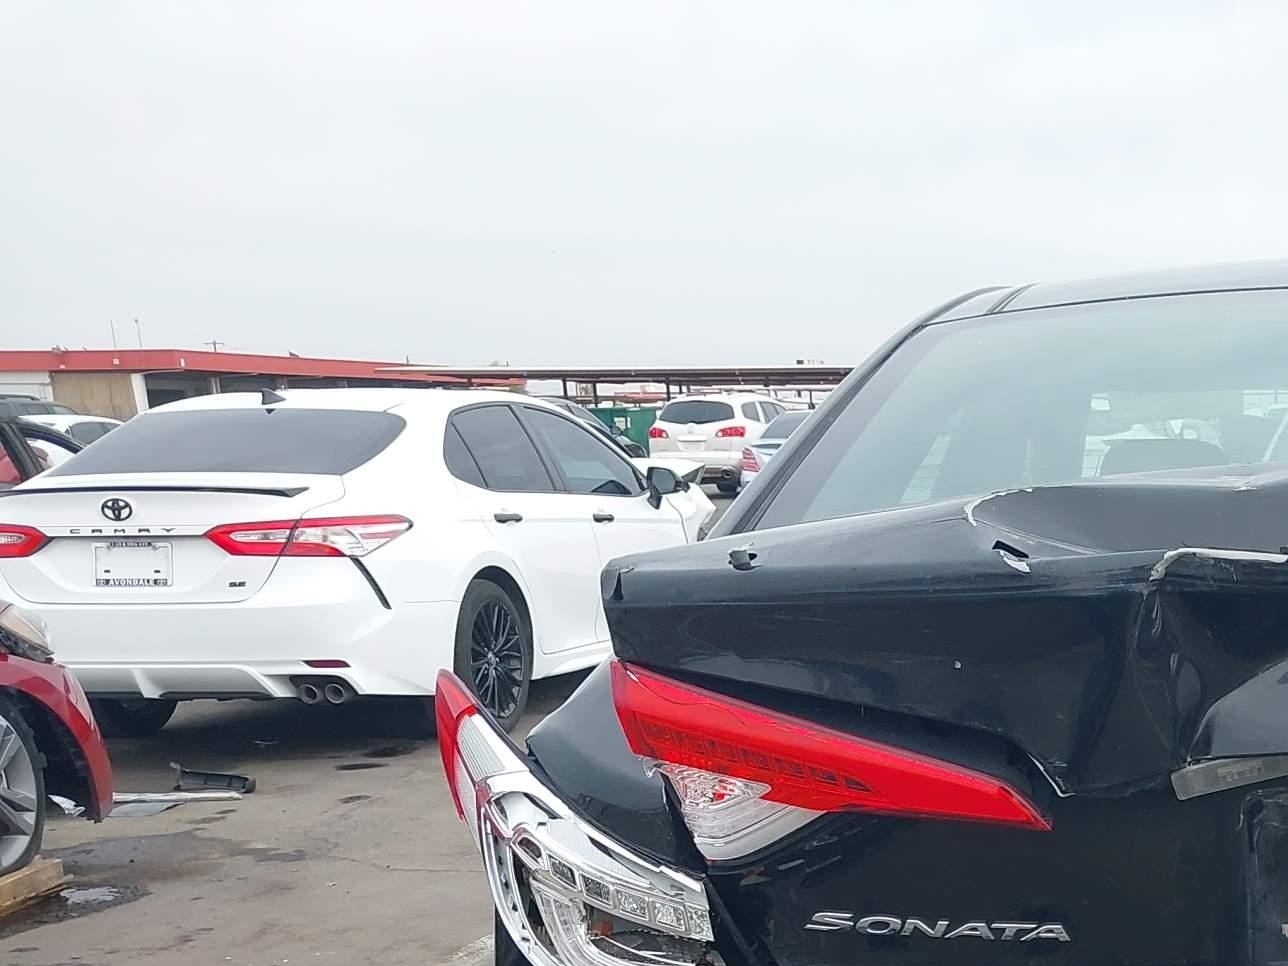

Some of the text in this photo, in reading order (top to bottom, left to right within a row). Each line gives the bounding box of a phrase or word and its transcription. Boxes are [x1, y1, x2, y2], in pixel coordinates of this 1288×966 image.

[109, 578, 154, 586] AVONDALE
[228, 580, 247, 588] SE
[804, 910, 1071, 942] SONATA
